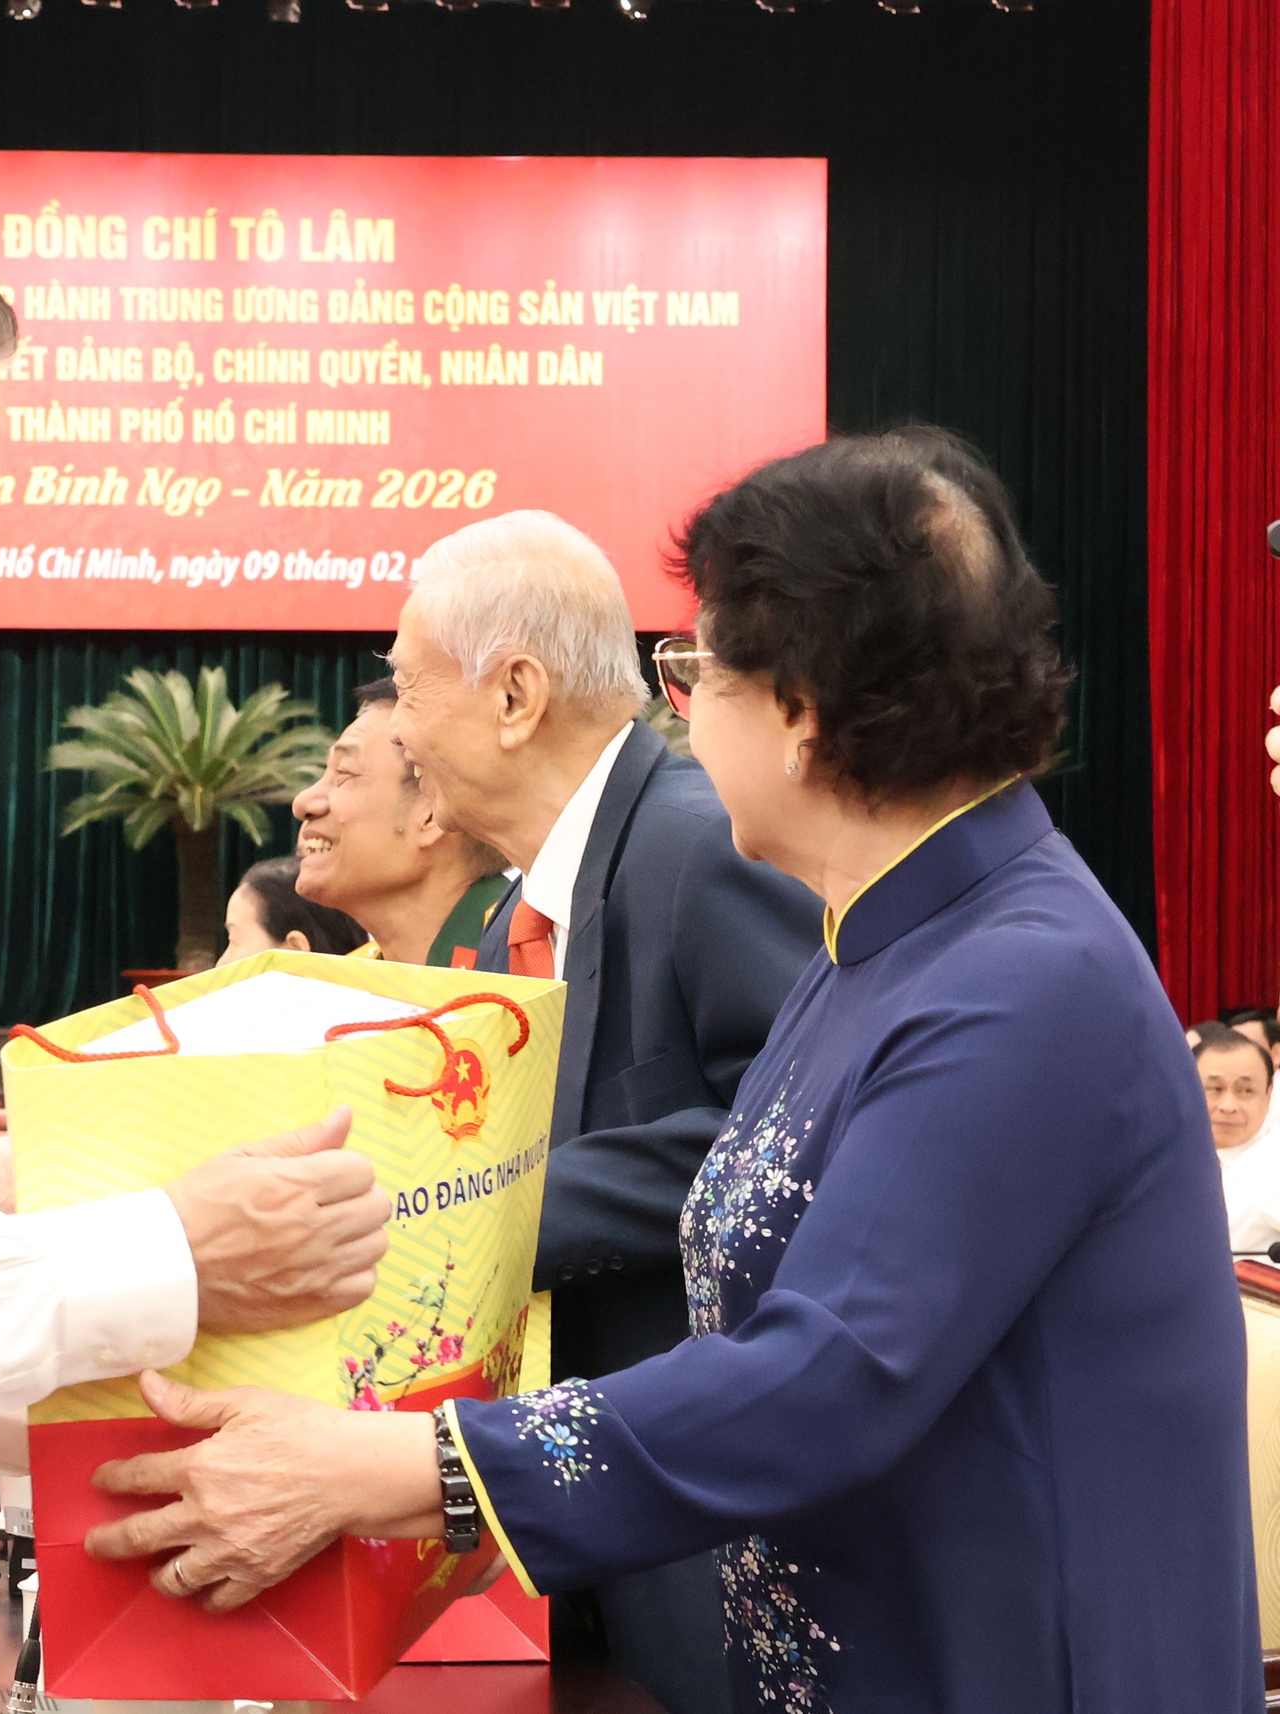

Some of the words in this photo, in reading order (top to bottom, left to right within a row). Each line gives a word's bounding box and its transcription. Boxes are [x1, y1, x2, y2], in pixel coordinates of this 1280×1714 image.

[2, 199, 127, 260] ĐỒNG
[142, 207, 217, 261] CHÍ
[230, 208, 284, 261] TÔ
[299, 208, 395, 263] LÂM
[24, 278, 110, 320] HÀNH
[120, 286, 223, 322] TRUNG
[233, 285, 319, 324] ƯƠNG
[327, 278, 414, 324] ĐẢNG
[423, 283, 510, 332] CỘNG
[519, 279, 584, 326] SẢN
[592, 283, 658, 334] VIỆT
[666, 291, 740, 326] NAM
[55, 335, 143, 381] ĐẢNG
[152, 341, 205, 390] BỘ,
[213, 341, 310, 384] CHÍNH
[319, 338, 431, 389] QUYỀN,
[440, 343, 529, 386] NHÂN
[537, 344, 604, 387] DÂN
[6, 400, 111, 442] THÀNH
[120, 396, 184, 443] PHỐ
[192, 397, 235, 444] HỒ
[243, 402, 297, 444] CHÍ
[306, 410, 391, 445] MINH
[23, 463, 129, 505] Bính
[136, 466, 222, 518] Ngọ
[258, 468, 363, 508] Năm
[370, 468, 497, 509] 2026
[37, 546, 86, 579] Chí
[84, 547, 165, 584] Minh,
[169, 548, 241, 588] ngày
[243, 550, 280, 581] 09
[283, 549, 367, 589] tháng
[370, 550, 407, 581] 02
[396, 1186, 429, 1229] ẠO
[436, 1167, 493, 1211] ĐẢNG
[497, 1148, 521, 1190] NHÀ
